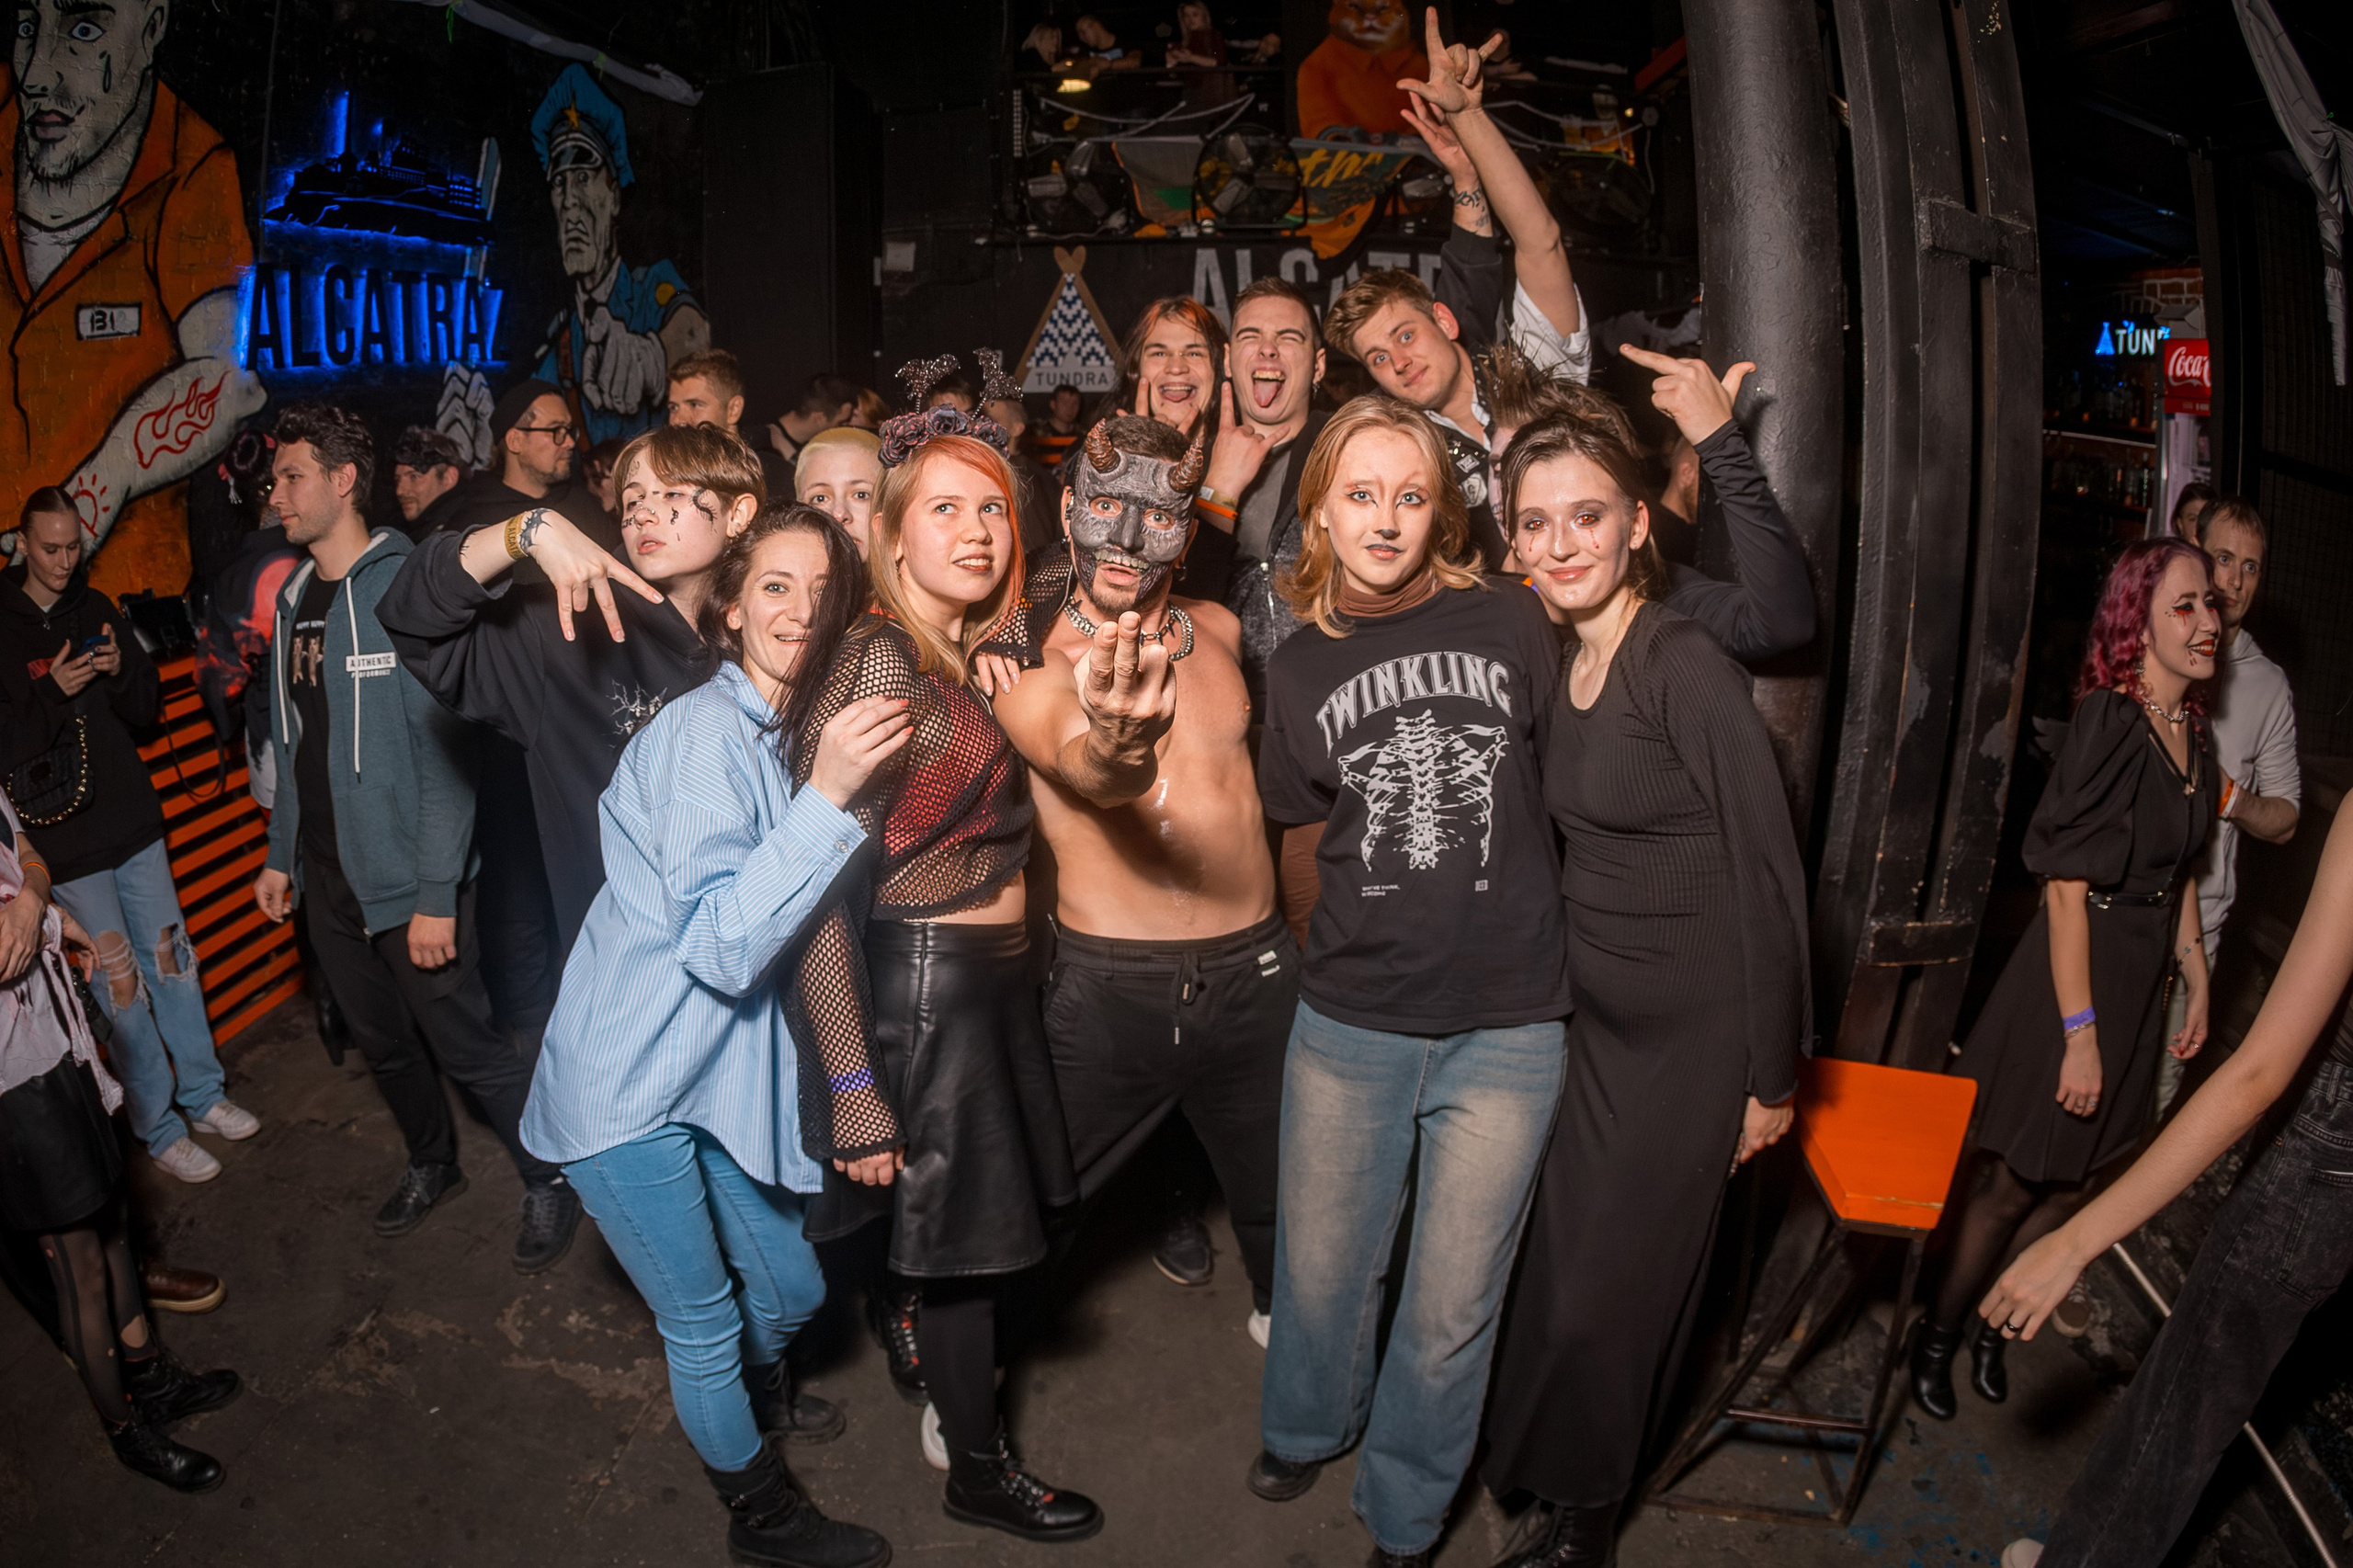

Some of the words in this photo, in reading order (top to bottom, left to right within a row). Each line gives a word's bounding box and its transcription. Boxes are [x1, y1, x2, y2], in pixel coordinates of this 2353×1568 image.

[246, 263, 507, 369] ALCATRAZ
[2115, 328, 2165, 356] TUN
[1036, 372, 1108, 386] TUNDRA
[1315, 652, 1512, 759] TWINKLING
